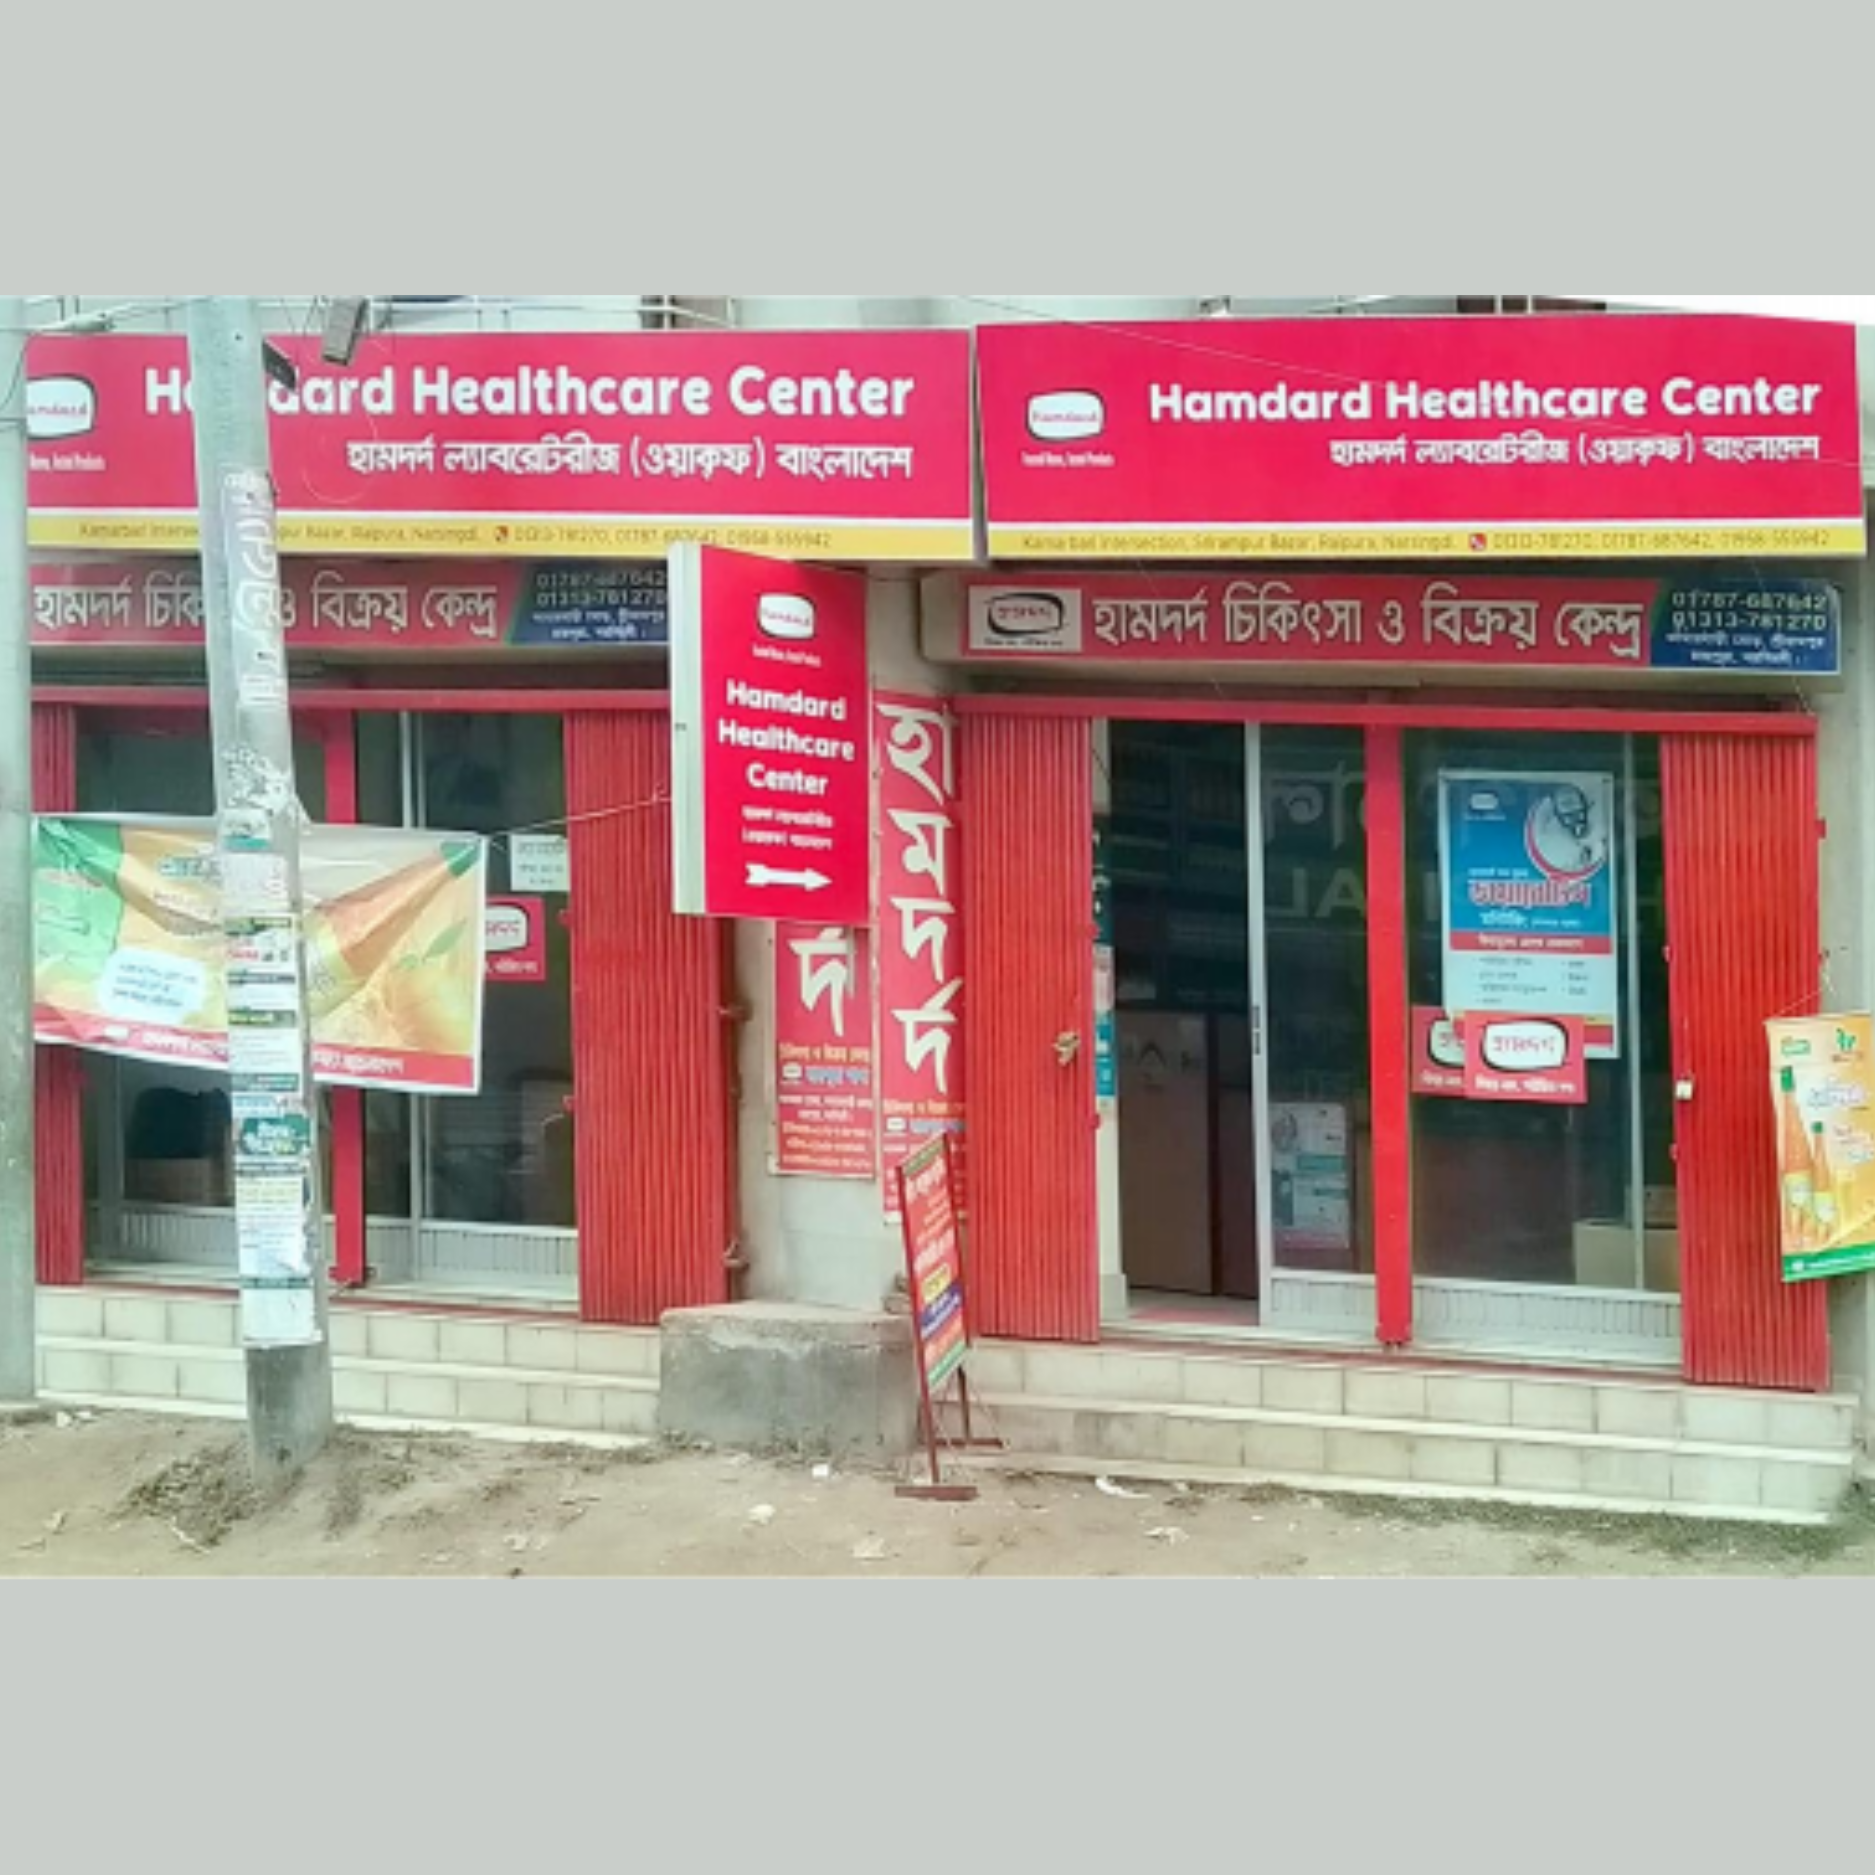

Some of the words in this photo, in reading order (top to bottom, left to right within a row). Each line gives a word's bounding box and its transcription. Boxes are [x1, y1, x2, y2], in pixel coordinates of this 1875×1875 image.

[146, 367, 394, 415] Hdard
[413, 366, 712, 415] Healthcare
[728, 364, 915, 417] Center
[1149, 381, 1372, 422] Hamdard
[1386, 380, 1648, 419] Healthcare
[1661, 377, 1822, 415] Center
[346, 434, 436, 474] হামদর্দ
[775, 441, 914, 481] বাংলাদেশ
[1329, 436, 1407, 466] হামদর্দ
[1702, 435, 1821, 465] বাংলাদেশ
[33, 575, 133, 629] হামদর্দ
[144, 570, 205, 629] চিকি
[312, 569, 408, 633] বিক্রয়
[420, 585, 498, 638] কেন্দ্র
[1092, 587, 1209, 645] হামদর্দ
[1222, 580, 1363, 645] চিকিৎসা
[1376, 600, 1406, 645] ও
[1423, 581, 1539, 650] বিক্রয়
[1554, 601, 1645, 659] কেন্দ্র
[725, 678, 847, 721] Hamdard
[717, 718, 855, 761] Healthcare
[745, 762, 830, 797] Center
